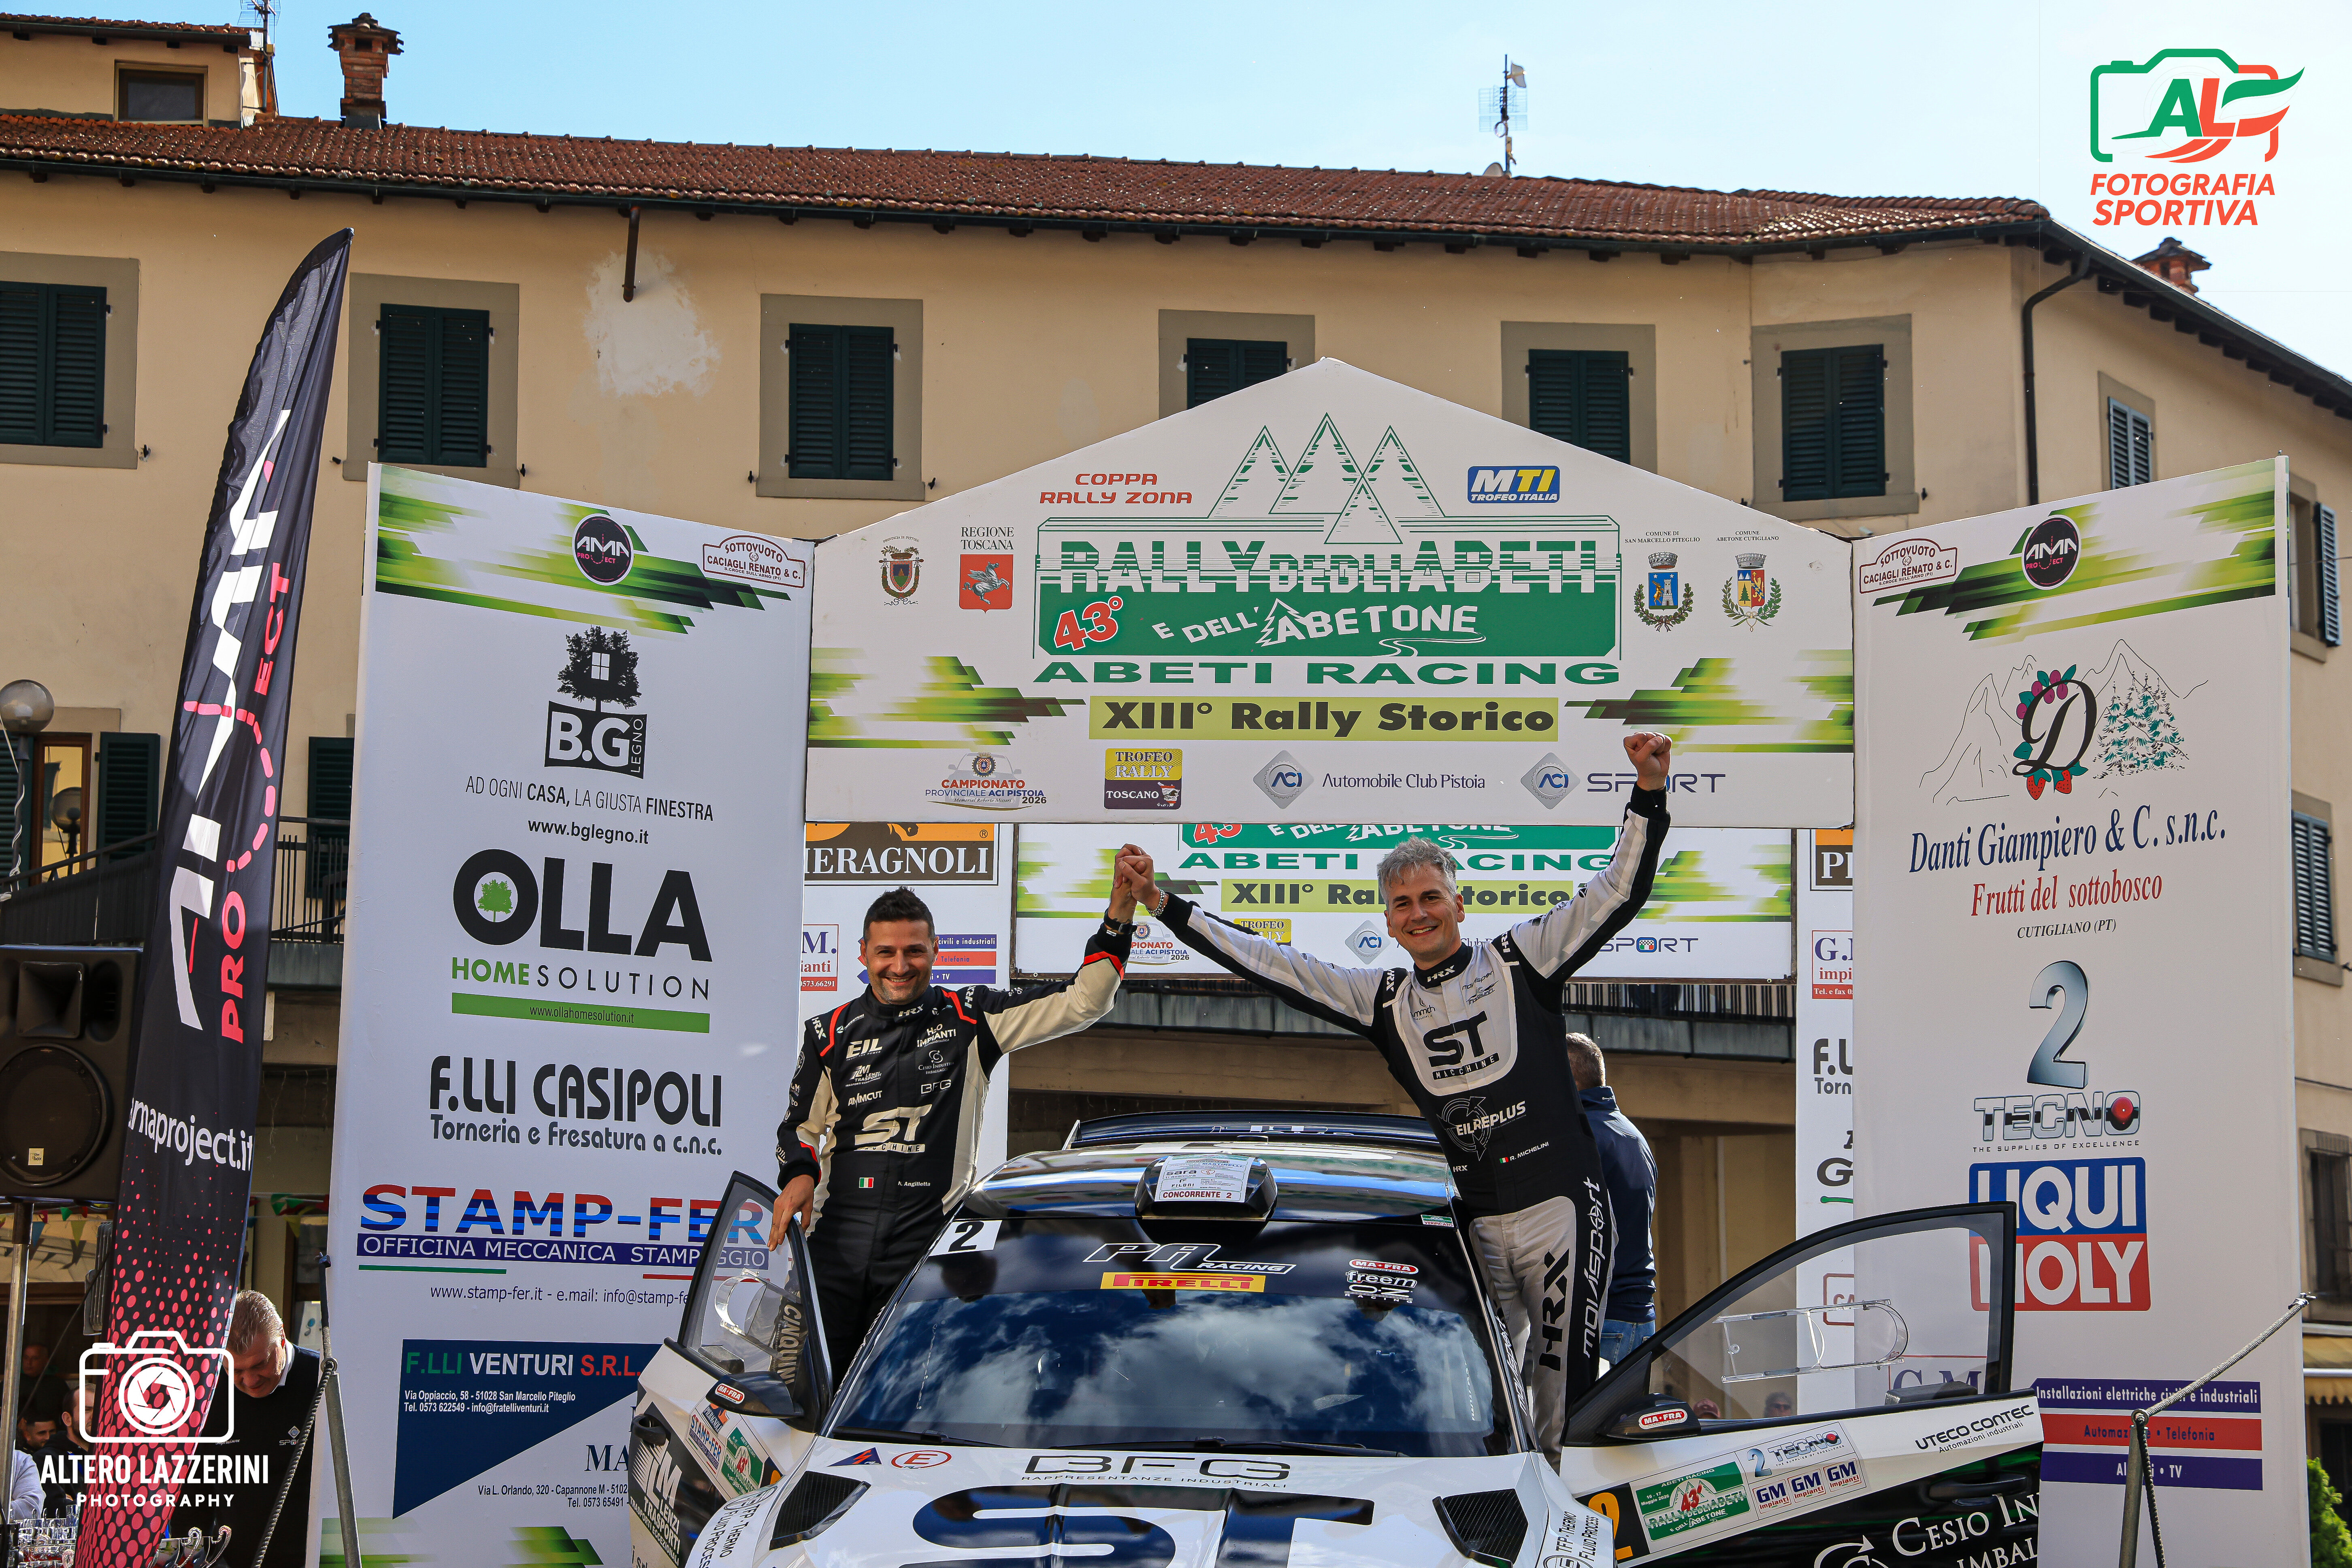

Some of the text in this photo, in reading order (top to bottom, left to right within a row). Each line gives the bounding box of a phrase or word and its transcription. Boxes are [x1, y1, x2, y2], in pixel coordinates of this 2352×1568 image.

[1075, 473, 1157, 486] COPPA
[1471, 470, 1555, 492] MTI
[1040, 492, 1193, 505] RALLY ZONA
[1519, 493, 1557, 502] ITALIA
[961, 527, 1014, 537] REGIONE
[725, 542, 783, 563] SOTTOVUOTO
[960, 540, 1014, 550] TOSCANA
[1881, 545, 1935, 567] SOTTOVUOTO
[707, 555, 781, 576] CACIAGLI RENATO
[746, 571, 771, 579] SULL'ARNO
[1060, 540, 1595, 593] RALLY DEGLI ABETI
[1864, 563, 1933, 584] CACIAGLI RENATO
[1275, 604, 1479, 643] ABETONE
[1033, 662, 1619, 684] ABETI RACING
[1231, 701, 1362, 737] Rally
[1378, 701, 1554, 731] Storico
[548, 710, 631, 765] B.G
[631, 718, 644, 773] LEGNO
[1116, 752, 1173, 762] TROFEO
[1115, 765, 1173, 778] RALLY
[1271, 771, 1485, 788] ACI Automobile Club Pistoia
[941, 779, 1025, 789] CAMPIONATO
[1538, 773, 1726, 793] ACI SPRT
[465, 775, 714, 822] AD OGNI CASA, LA GIUSTA FINESTRA
[528, 820, 649, 845] www.bglegno.it
[1909, 804, 2225, 873] Danti Giampiero & C. s.n.c.
[805, 847, 989, 874] IERAGNOLI
[1971, 869, 2162, 917] Frutti del sottobosco
[453, 848, 713, 962] OLLA
[2017, 918, 2117, 939] CUTIGLIANO (PT)
[452, 957, 709, 1001] HOME SOLUTION
[529, 1004, 635, 1024] www.ollahomesolution.it
[2027, 960, 2090, 1090] 2
[847, 1038, 883, 1059] EIL
[1423, 1010, 1488, 1067] ST
[1436, 1055, 1495, 1078] MACCHINE
[430, 1055, 722, 1128] F.LLI CASIPOLI
[1974, 1090, 2141, 1141] TECNO
[430, 1113, 722, 1155] Torneria Fresatura c.n.c.
[2073, 1140, 2140, 1149] EXCELLENCE
[1517, 1142, 1549, 1158] MICHELINI
[360, 1184, 767, 1245] STAMP-FER
[948, 1221, 985, 1252] 2
[363, 1237, 765, 1266] OFFICINA MECCANICA STAMPGGIO
[1113, 1274, 1254, 1289] PIRELLI
[1346, 1271, 1417, 1288] freem
[430, 1286, 688, 1307] www.stamp-fer.it e.mail: info@stamp-fe
[1539, 1248, 1570, 1371] HRX
[406, 1352, 641, 1376] F.LLI VENTURI S.R.L.
[405, 1390, 575, 1404] Via Oppiaccio, 51028 San Marcello Piteglio
[2036, 1387, 2258, 1403] Installazioni elettriche industriali
[404, 1403, 549, 1414] Tel. 0573 622549 info@fratelliventuri.it
[691, 1415, 722, 1461] STAMP-FER
[1915, 1404, 2035, 1450] UTECO CONTEC
[1938, 1420, 2024, 1455] Automazioni industriali
[2167, 1427, 2215, 1441] Telefonia
[478, 1484, 597, 1498] Via Orlando, 320 Capannone
[1181, 1478, 1286, 1488] INDUSTRIALI
[1756, 1483, 1787, 1503] GM
[602, 1498, 624, 1507] 65491
[644, 1497, 680, 1554] TRASPORTI
[660, 1499, 679, 1534] LENZI
